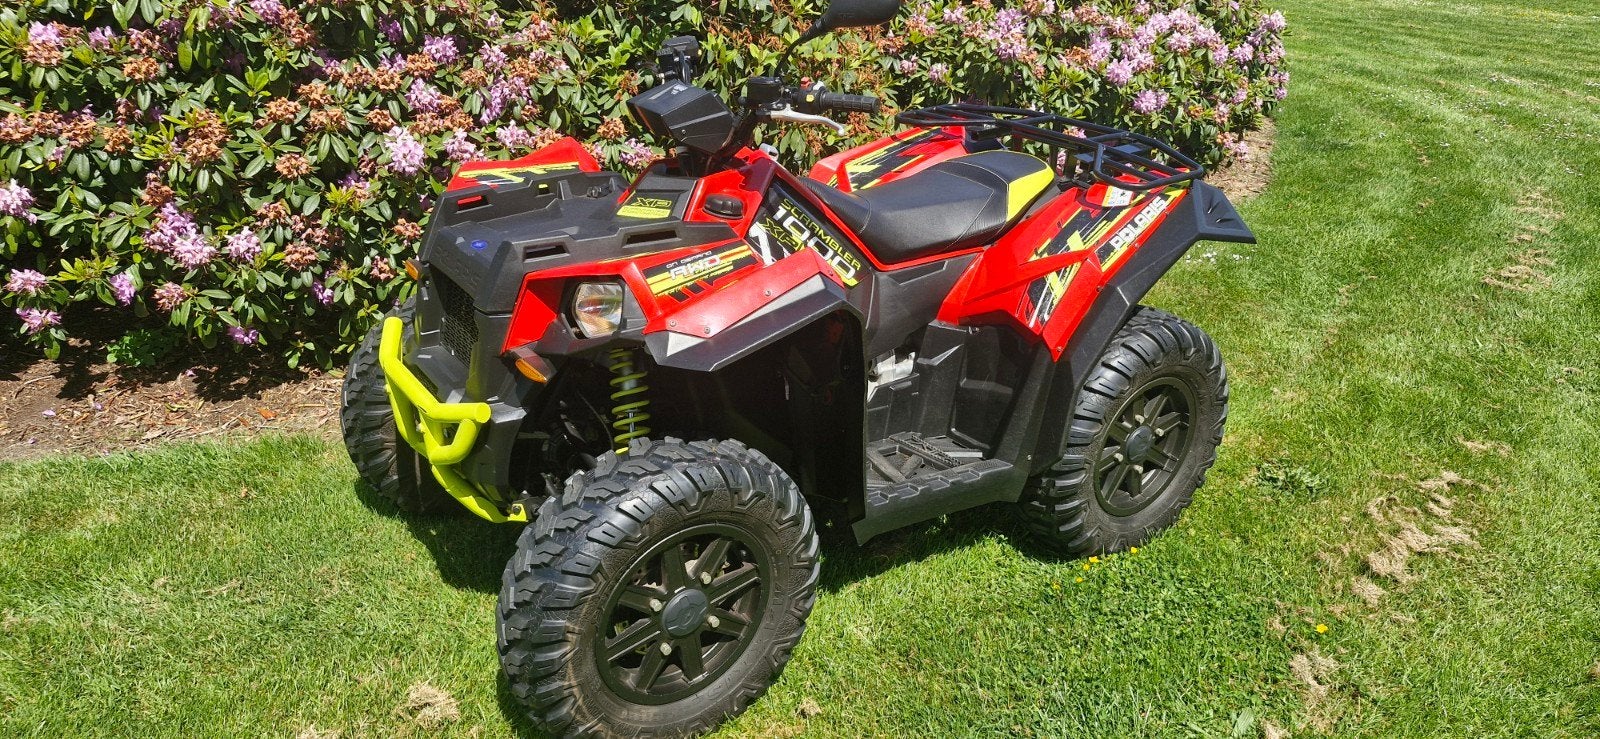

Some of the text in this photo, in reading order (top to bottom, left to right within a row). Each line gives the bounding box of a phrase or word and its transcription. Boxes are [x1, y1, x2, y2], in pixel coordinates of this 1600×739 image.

[630, 197, 672, 207] XP
[1109, 196, 1167, 250] POLARIS
[762, 217, 804, 251] XP
[772, 205, 856, 280] 1000
[780, 198, 861, 271] SCRAMBLER
[669, 254, 721, 280] AWD
